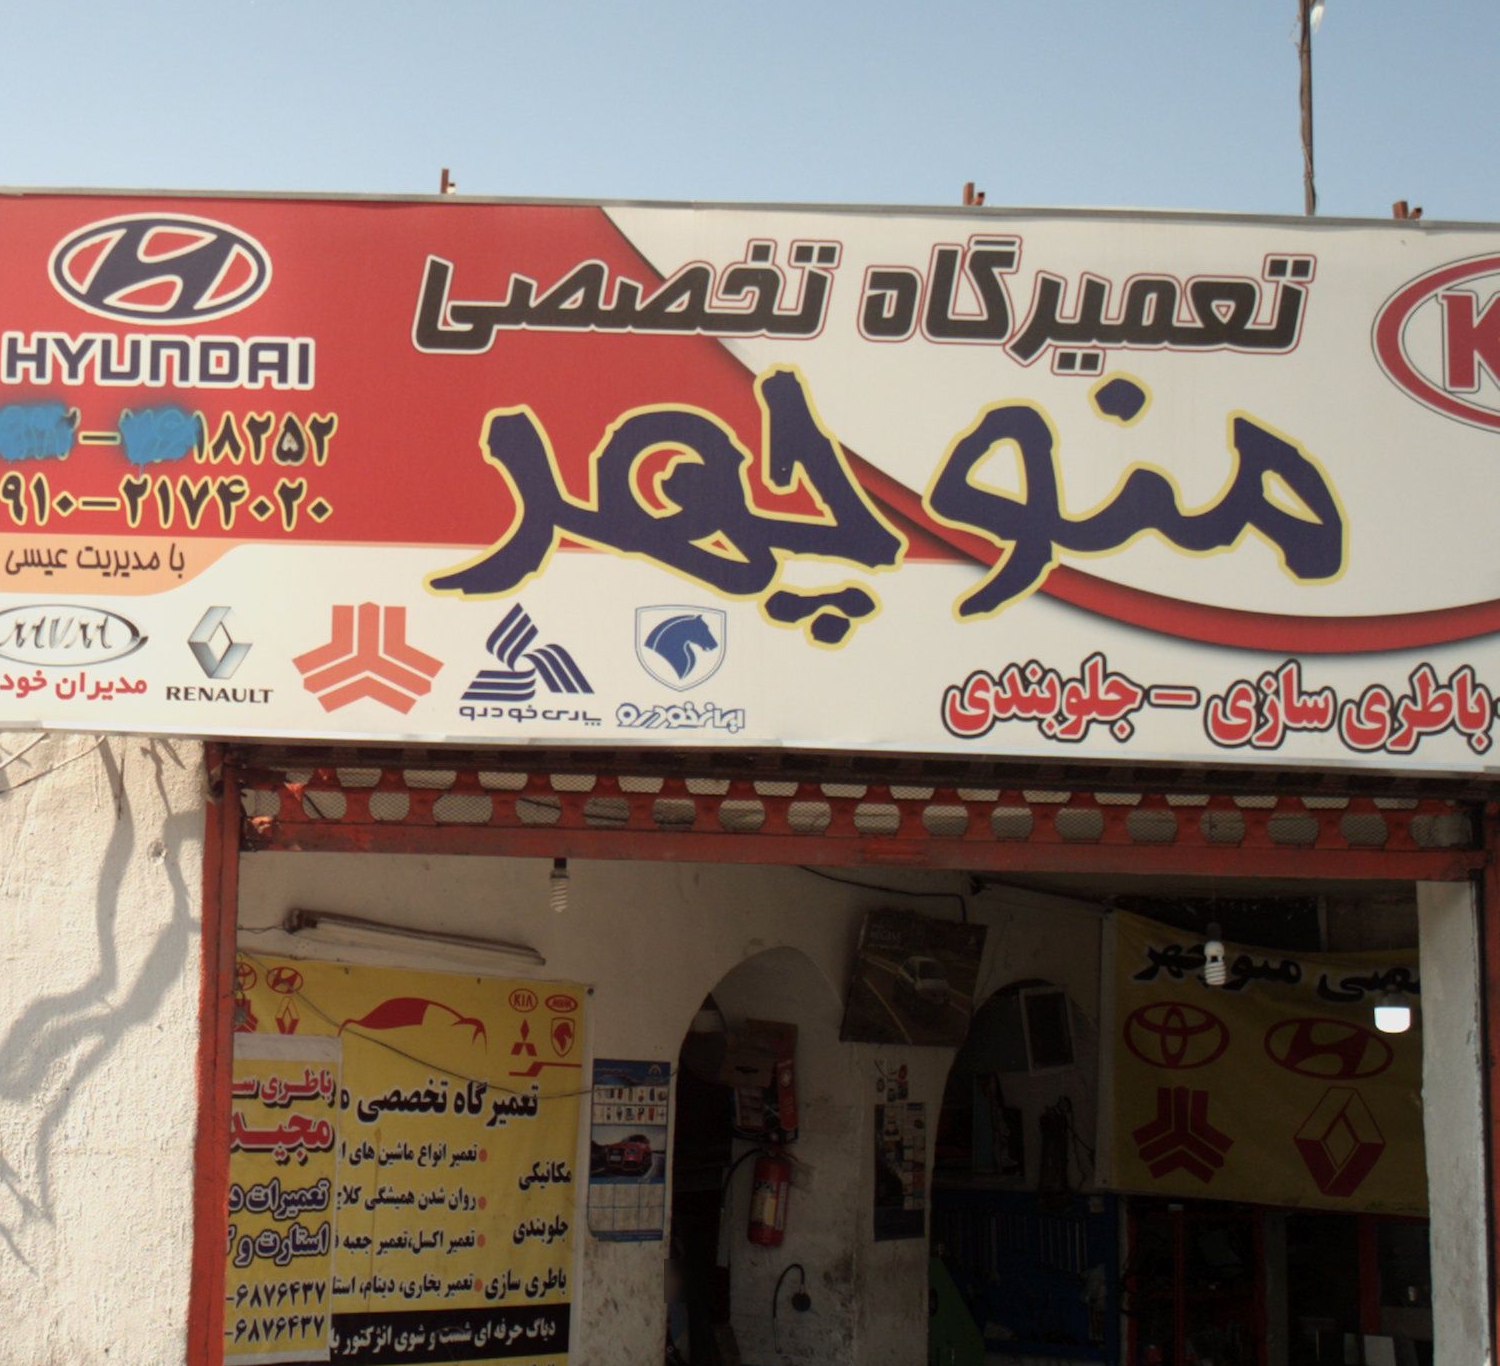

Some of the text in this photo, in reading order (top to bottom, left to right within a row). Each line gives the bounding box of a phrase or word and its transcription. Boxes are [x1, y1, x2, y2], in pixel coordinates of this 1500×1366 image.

[412, 234, 1317, 376] تعمیرگاه تخصصی
[1, 331, 316, 390] HYUNDAI
[424, 362, 1349, 650] منوچهر
[5, 546, 69, 577] عیسی
[76, 546, 161, 578] مدیریت
[169, 543, 186, 579] با
[55, 671, 148, 701] مدیران
[165, 685, 275, 705] RENAULT
[459, 704, 538, 723] خودرو
[1203, 658, 1338, 751] سازی
[1338, 661, 1493, 756] باطری
[261, 1068, 336, 1109] باطری
[357, 1078, 449, 1123] تخصصی
[349, 1141, 375, 1165] های
[378, 1142, 414, 1166] ماشین
[417, 1143, 447, 1167] انواع
[449, 1144, 478, 1168] تعمیر
[519, 1160, 573, 1190] مکانیکی
[245, 1176, 332, 1222] تعمیرات
[364, 1187, 415, 1211] همیشگی
[417, 1186, 445, 1211] شدن
[448, 1187, 477, 1212] روان
[446, 1230, 475, 1255] تعمیر
[512, 1214, 569, 1244] جلوبندی
[233, 1235, 255, 1269] و
[254, 1221, 331, 1268] استارت
[342, 1237, 372, 1256] جعبه
[444, 1273, 473, 1298] تعمیر
[484, 1267, 567, 1300] باطری سازی
